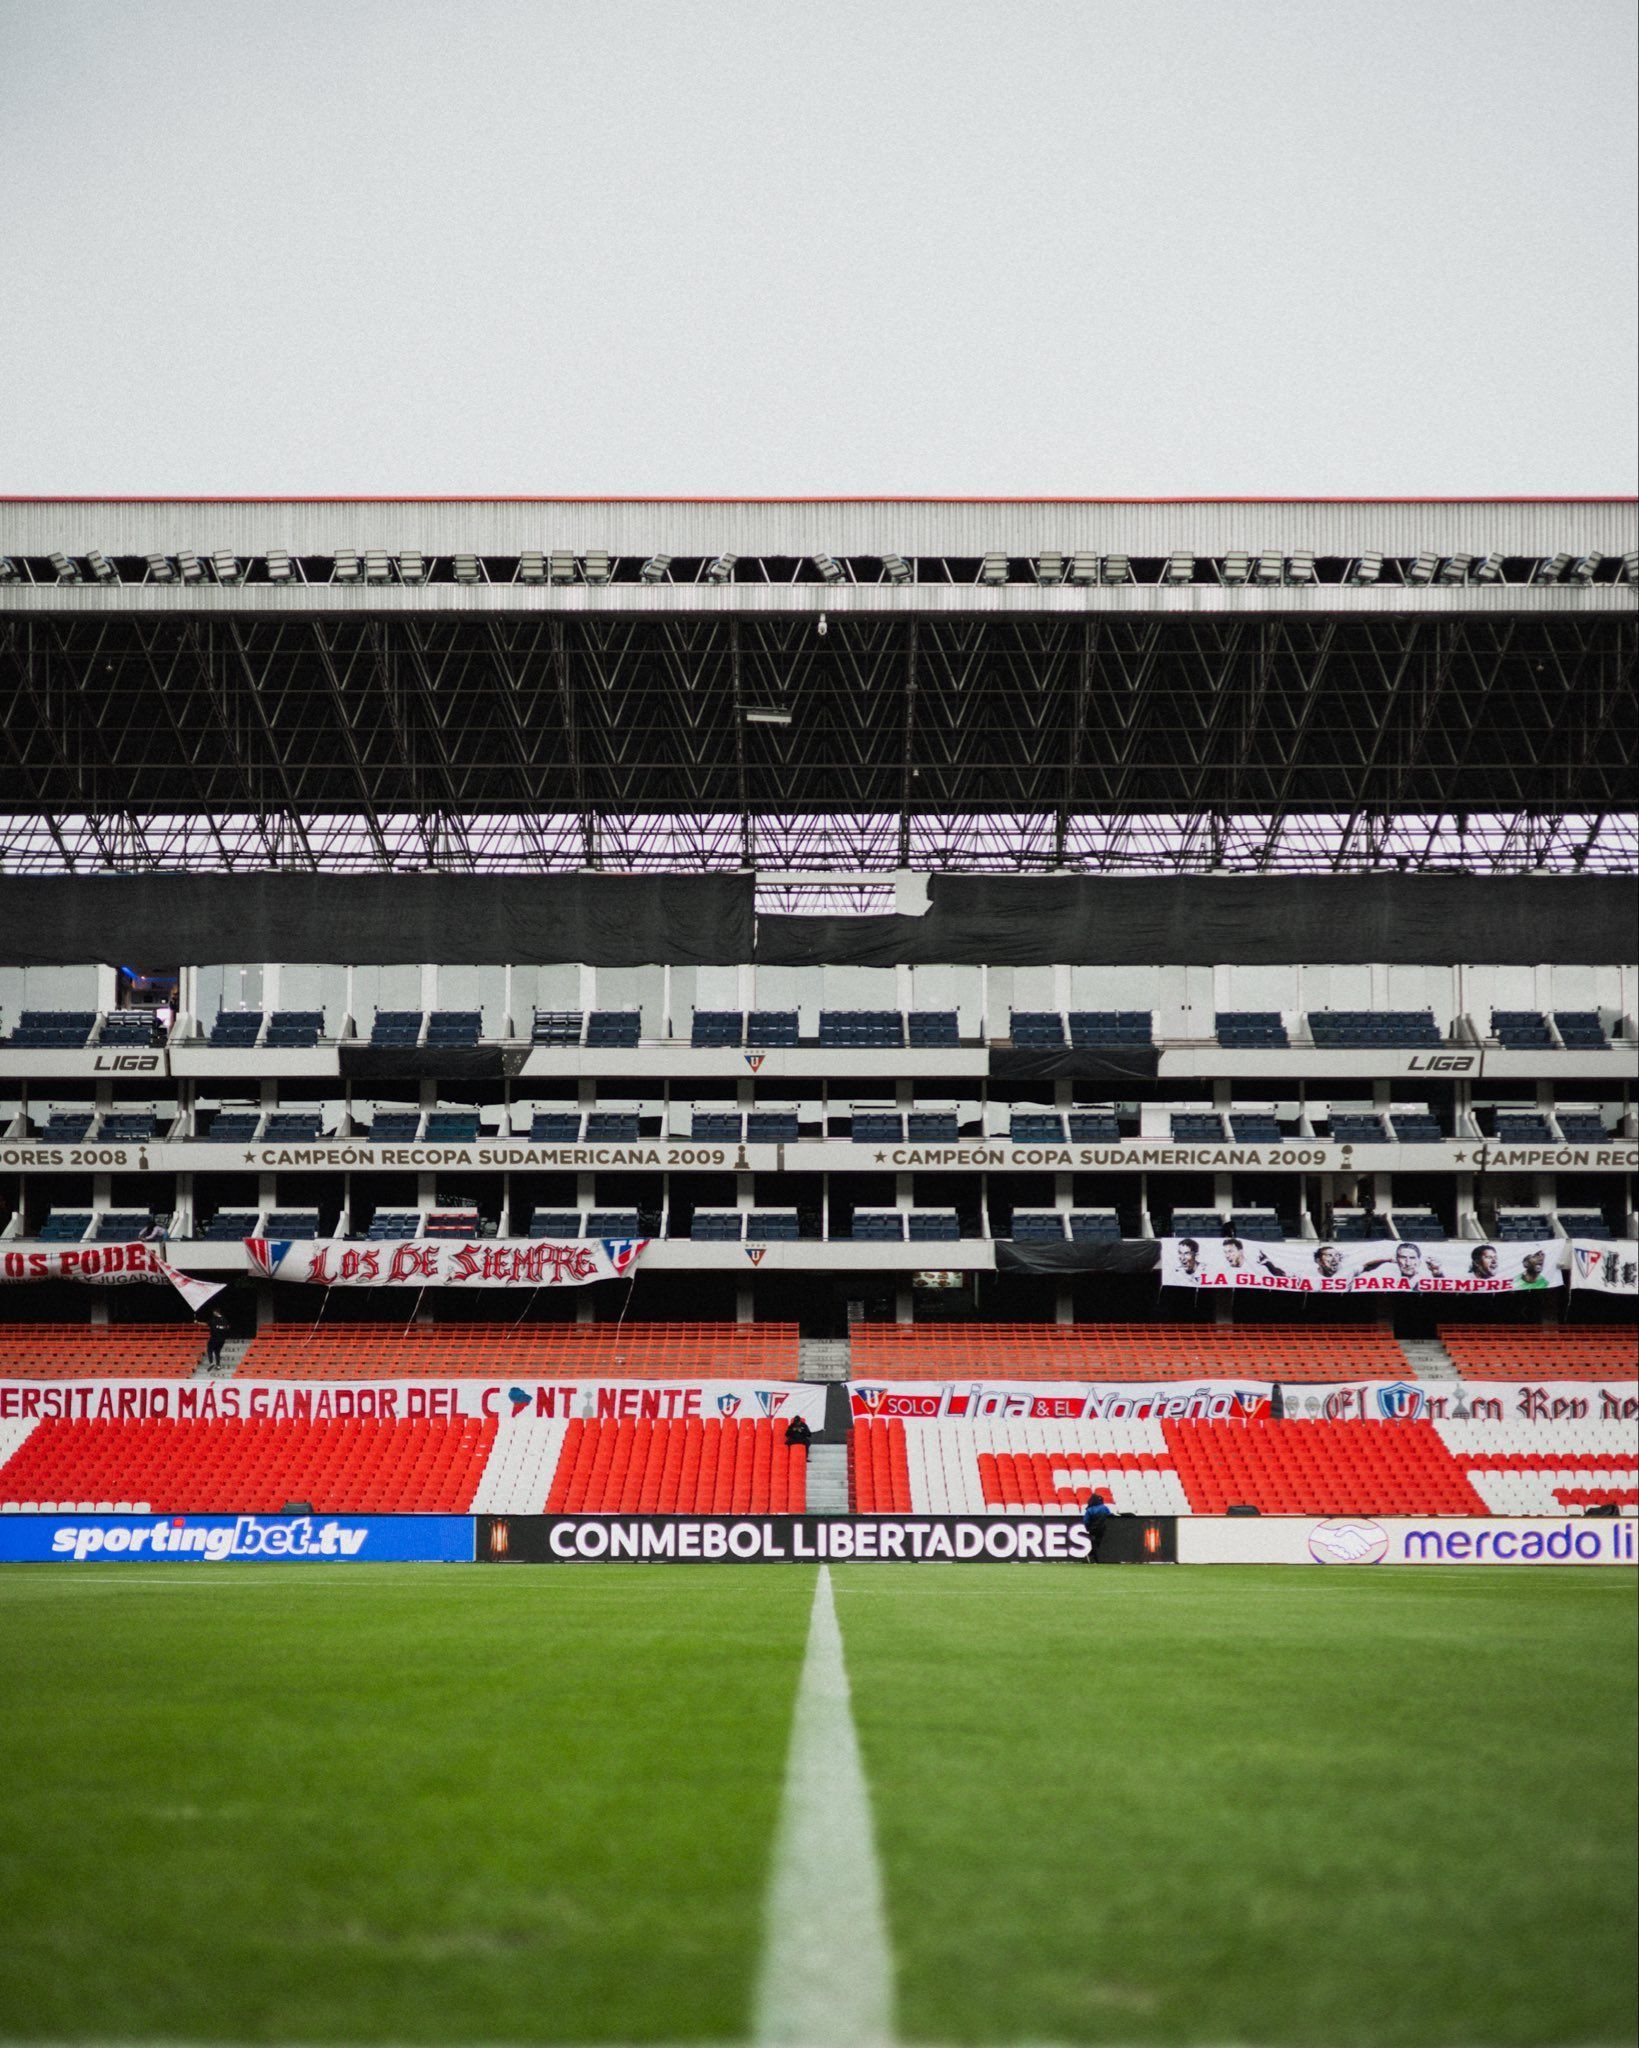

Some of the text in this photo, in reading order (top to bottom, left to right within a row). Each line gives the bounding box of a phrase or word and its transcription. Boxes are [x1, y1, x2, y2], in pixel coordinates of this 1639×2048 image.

[0, 1150, 127, 1165] ORES 2008
[262, 1146, 725, 1165] CAMPEÓN RECOPA SUDAMERICANA 2009
[892, 1146, 1326, 1165] CAMPEÓN COPA SUDAMERICANA 2009
[1472, 1147, 1589, 1166] CAMPEÓN
[5, 1252, 48, 1277] OS
[1201, 1273, 1514, 1291] LA GLORIA ES PARA SIEMPRE
[178, 1381, 241, 1419] MÁS
[250, 1388, 398, 1419] GANADOR
[408, 1388, 469, 1419] DEL
[887, 1398, 937, 1414] SOLO
[1036, 1401, 1050, 1417] &
[1054, 1400, 1076, 1417] EL
[52, 1516, 368, 1560] sportingbet.tv
[549, 1522, 1092, 1558] CONMEBOL LIBERTADORES
[1404, 1523, 1633, 1559] mercado li
